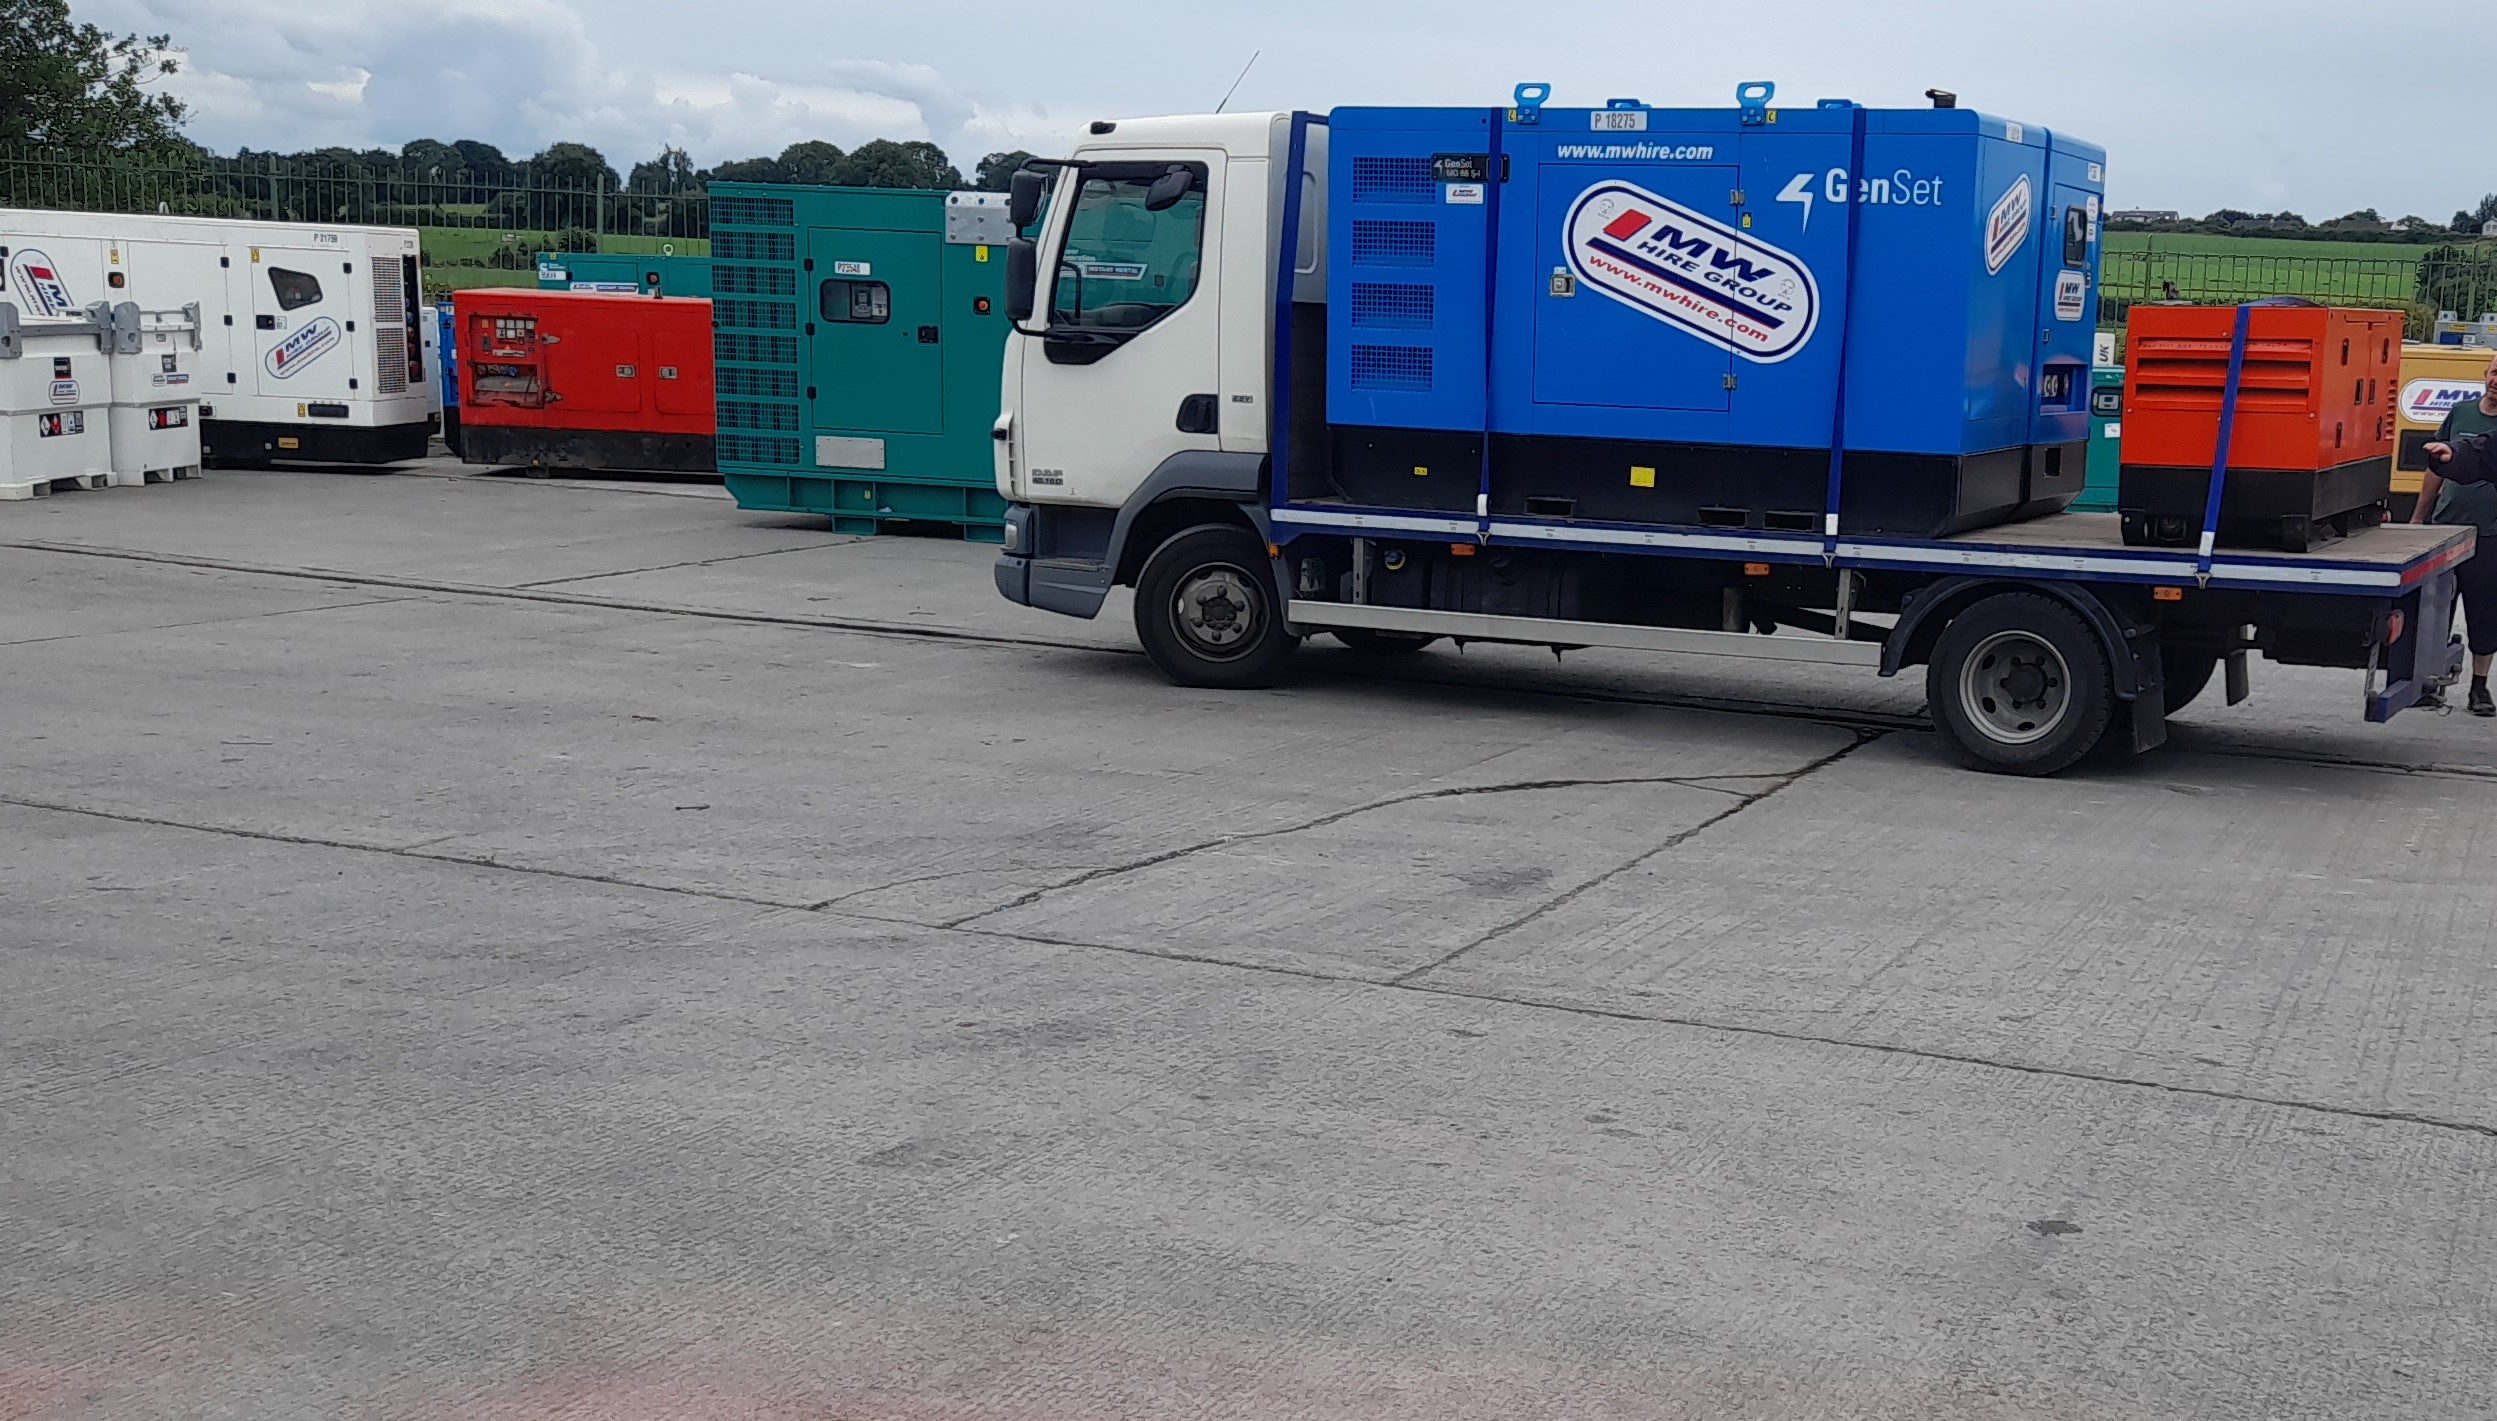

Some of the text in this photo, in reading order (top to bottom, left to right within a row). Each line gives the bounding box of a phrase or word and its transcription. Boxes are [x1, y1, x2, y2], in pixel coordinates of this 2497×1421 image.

[1594, 113, 1636, 129] P 18275
[1557, 141, 1714, 160] www.mwhire.com
[1825, 167, 1944, 206] GenSet
[2000, 189, 2022, 225] MW
[1651, 224, 1777, 283] MW
[1636, 241, 1794, 314] HIRE GROUP
[2064, 282, 2080, 294] MW
[1589, 255, 1770, 344] www.mwhire.com
[285, 324, 318, 353] MW
